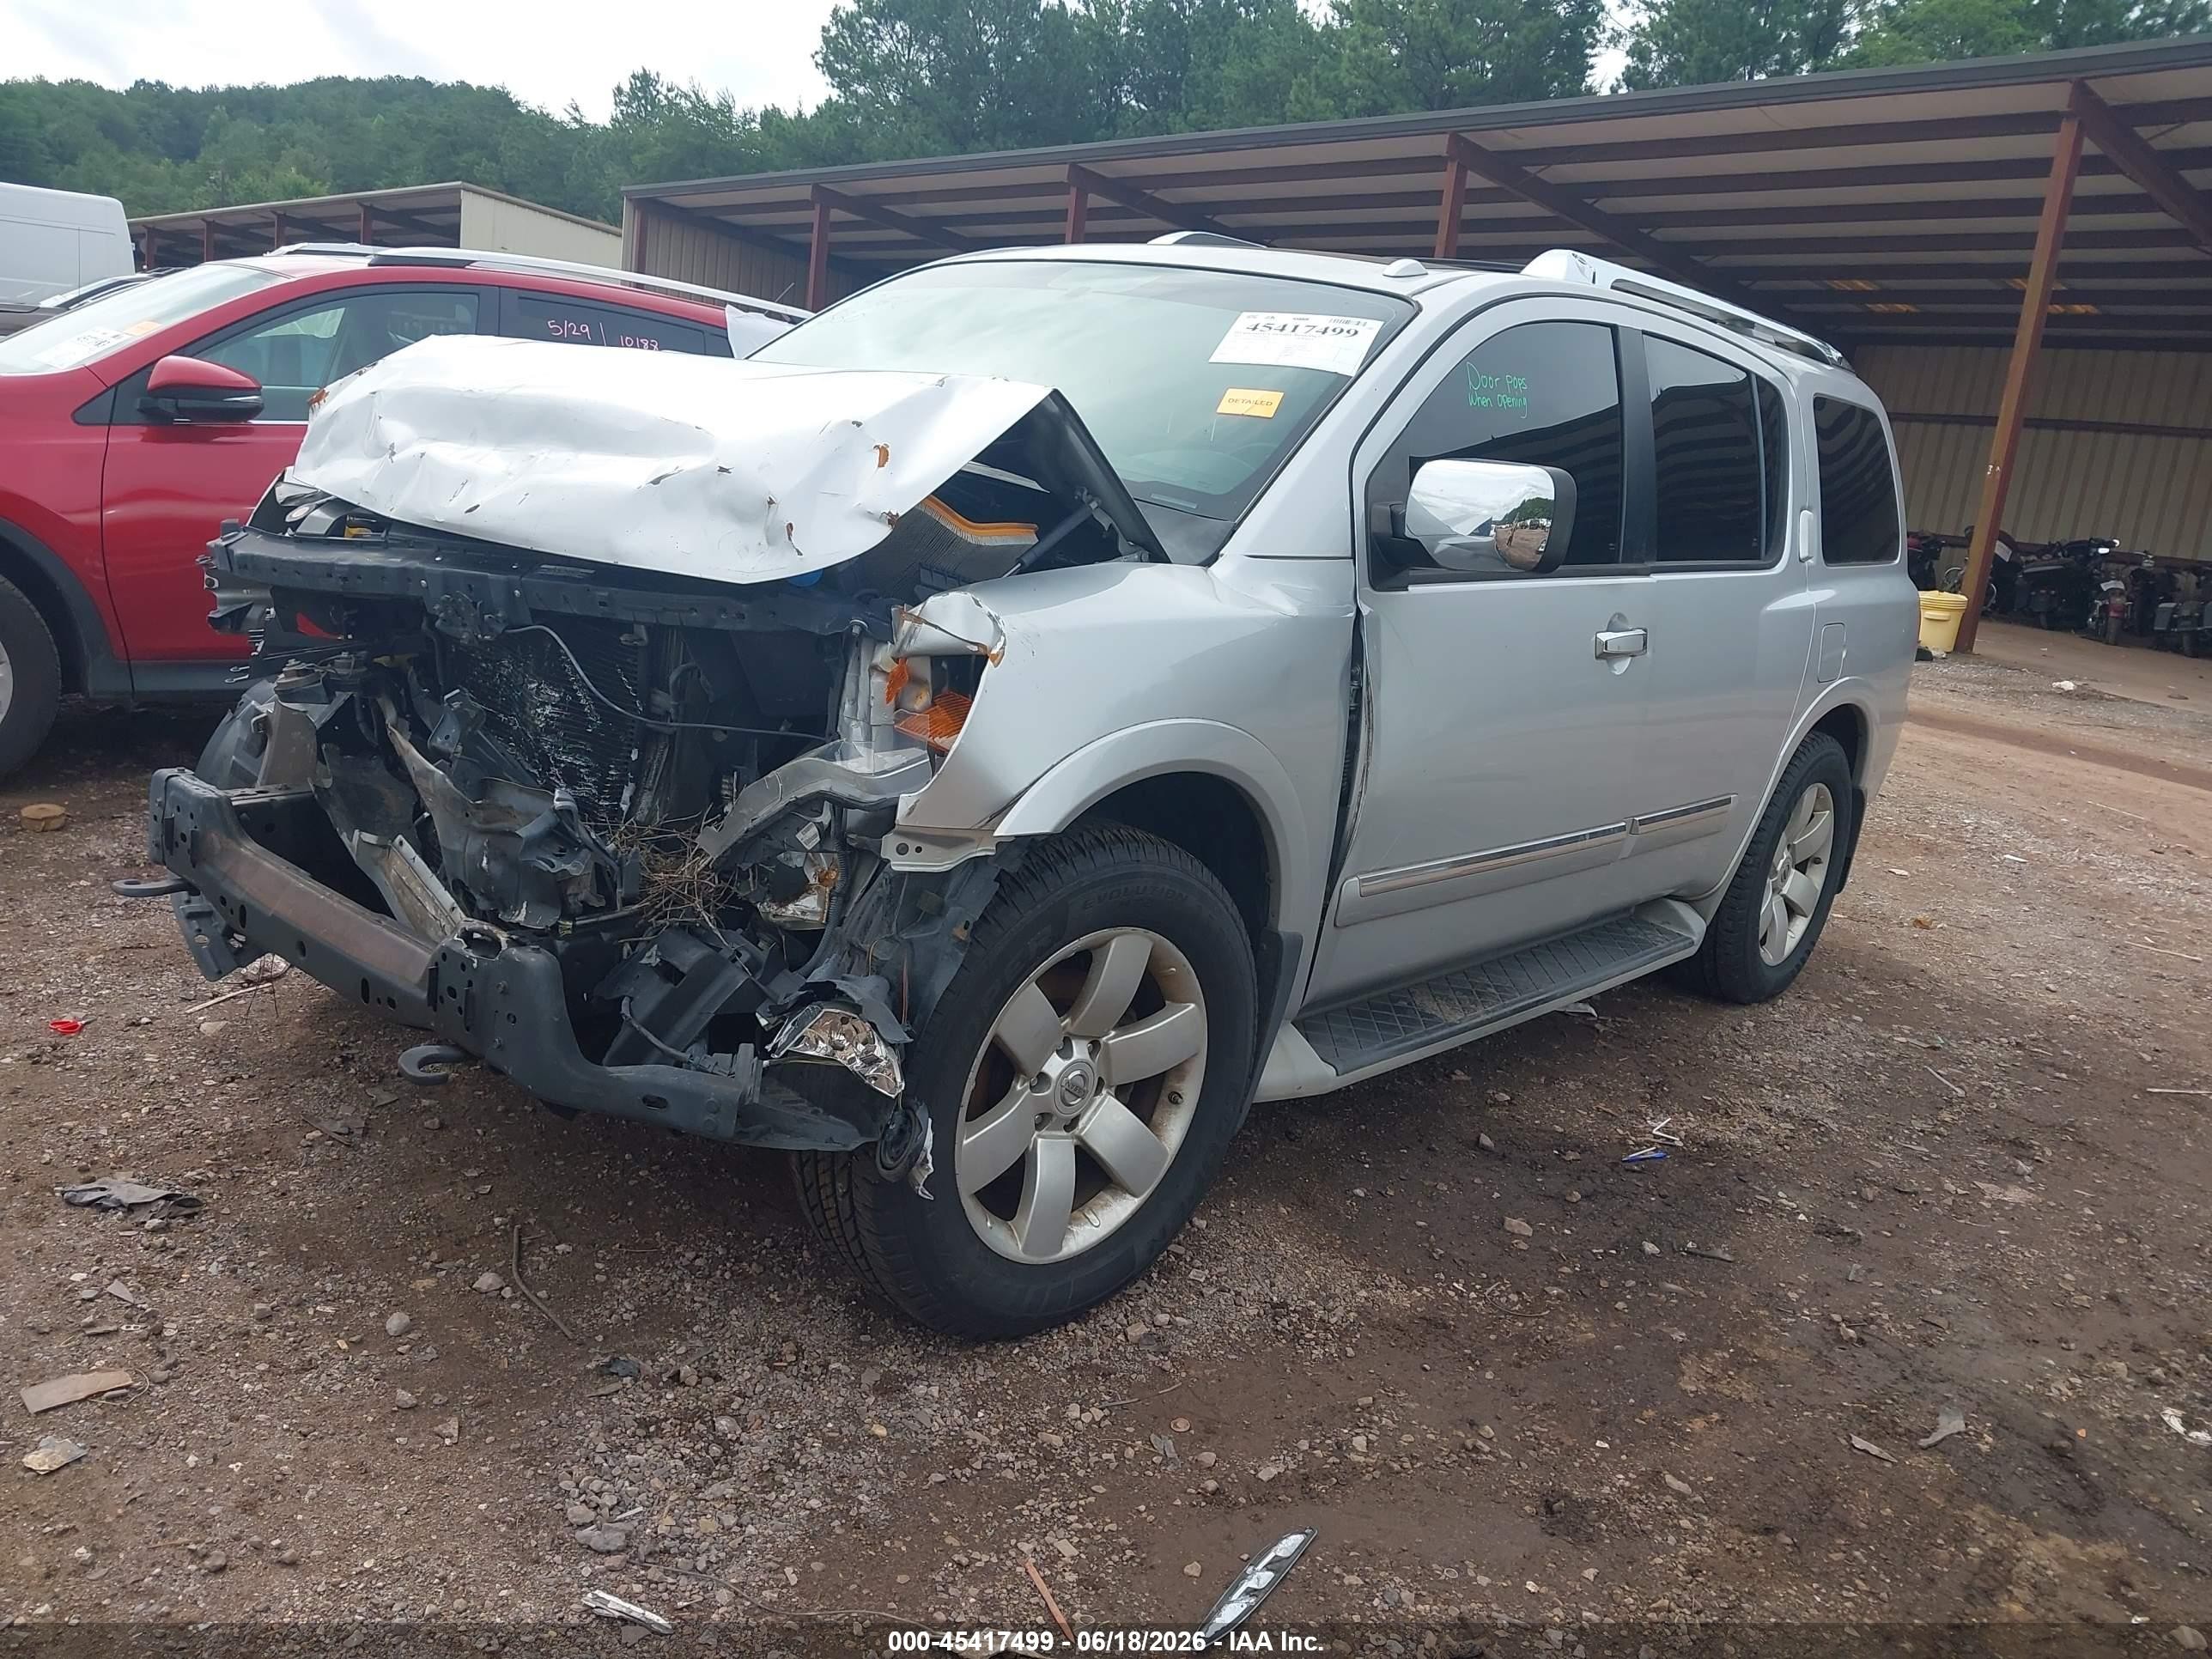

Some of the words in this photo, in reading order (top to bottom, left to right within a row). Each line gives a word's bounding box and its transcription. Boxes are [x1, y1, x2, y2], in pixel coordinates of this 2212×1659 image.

[547, 319, 592, 341] 5/29
[1246, 322, 1359, 338] 45417499
[1466, 362, 1500, 390] Door
[1228, 398, 1273, 406] DETAILED
[1468, 392, 1493, 407] When
